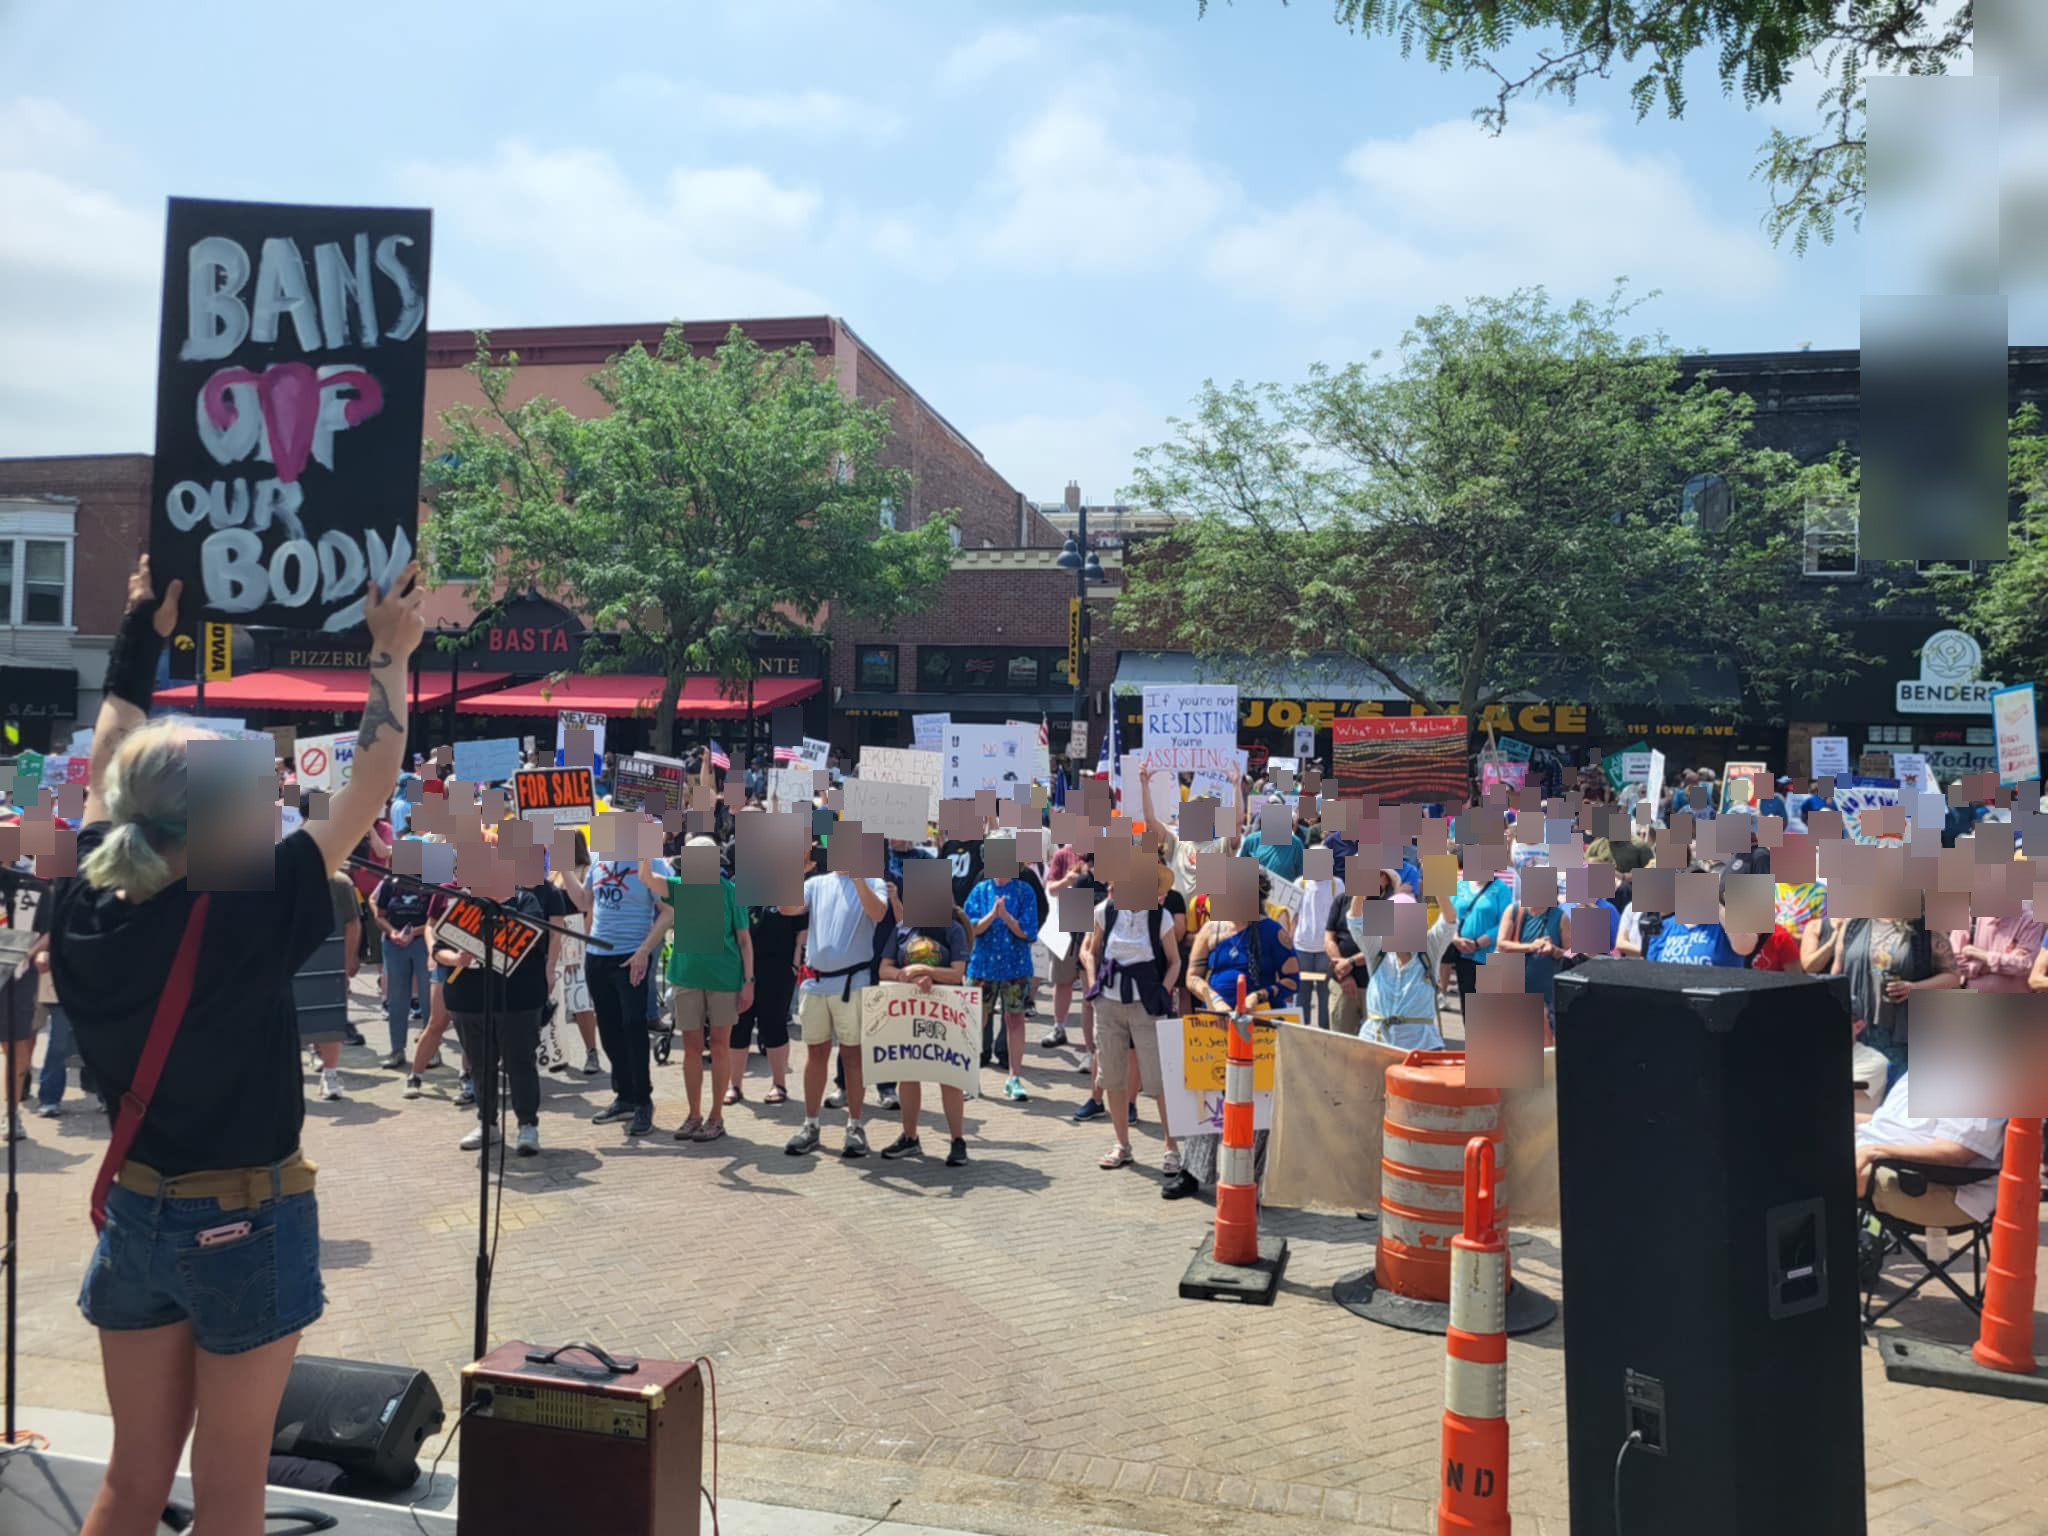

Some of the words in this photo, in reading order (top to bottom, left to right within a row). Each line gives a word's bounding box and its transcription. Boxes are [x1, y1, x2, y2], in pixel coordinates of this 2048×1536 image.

[179, 233, 425, 361] BANS
[166, 478, 305, 538] OUR
[202, 525, 413, 632] BODY
[210, 623, 226, 672] OWA
[489, 627, 569, 652] BASTA
[1145, 692, 1171, 708] If
[1216, 695, 1236, 707] not
[559, 711, 606, 727] NEVER
[1149, 711, 1237, 735] RESISTING
[1243, 701, 1384, 730] JOE'S
[1410, 702, 1587, 733] ACE
[1336, 724, 1373, 737] What
[1627, 724, 1649, 735] 115
[1655, 724, 1696, 736] IOWA
[1702, 724, 1739, 737] AVE.
[1145, 747, 1230, 769] ASSISTING
[517, 773, 549, 808] FOR
[551, 770, 591, 806] SALE
[1863, 794, 1899, 807] KIN
[447, 899, 483, 935] FOR
[490, 912, 536, 958] ALE
[1663, 943, 1693, 957] NOT
[888, 998, 967, 1029] CITIZENS
[913, 1018, 948, 1041] FOR
[873, 1044, 972, 1071] DEMOCRACY
